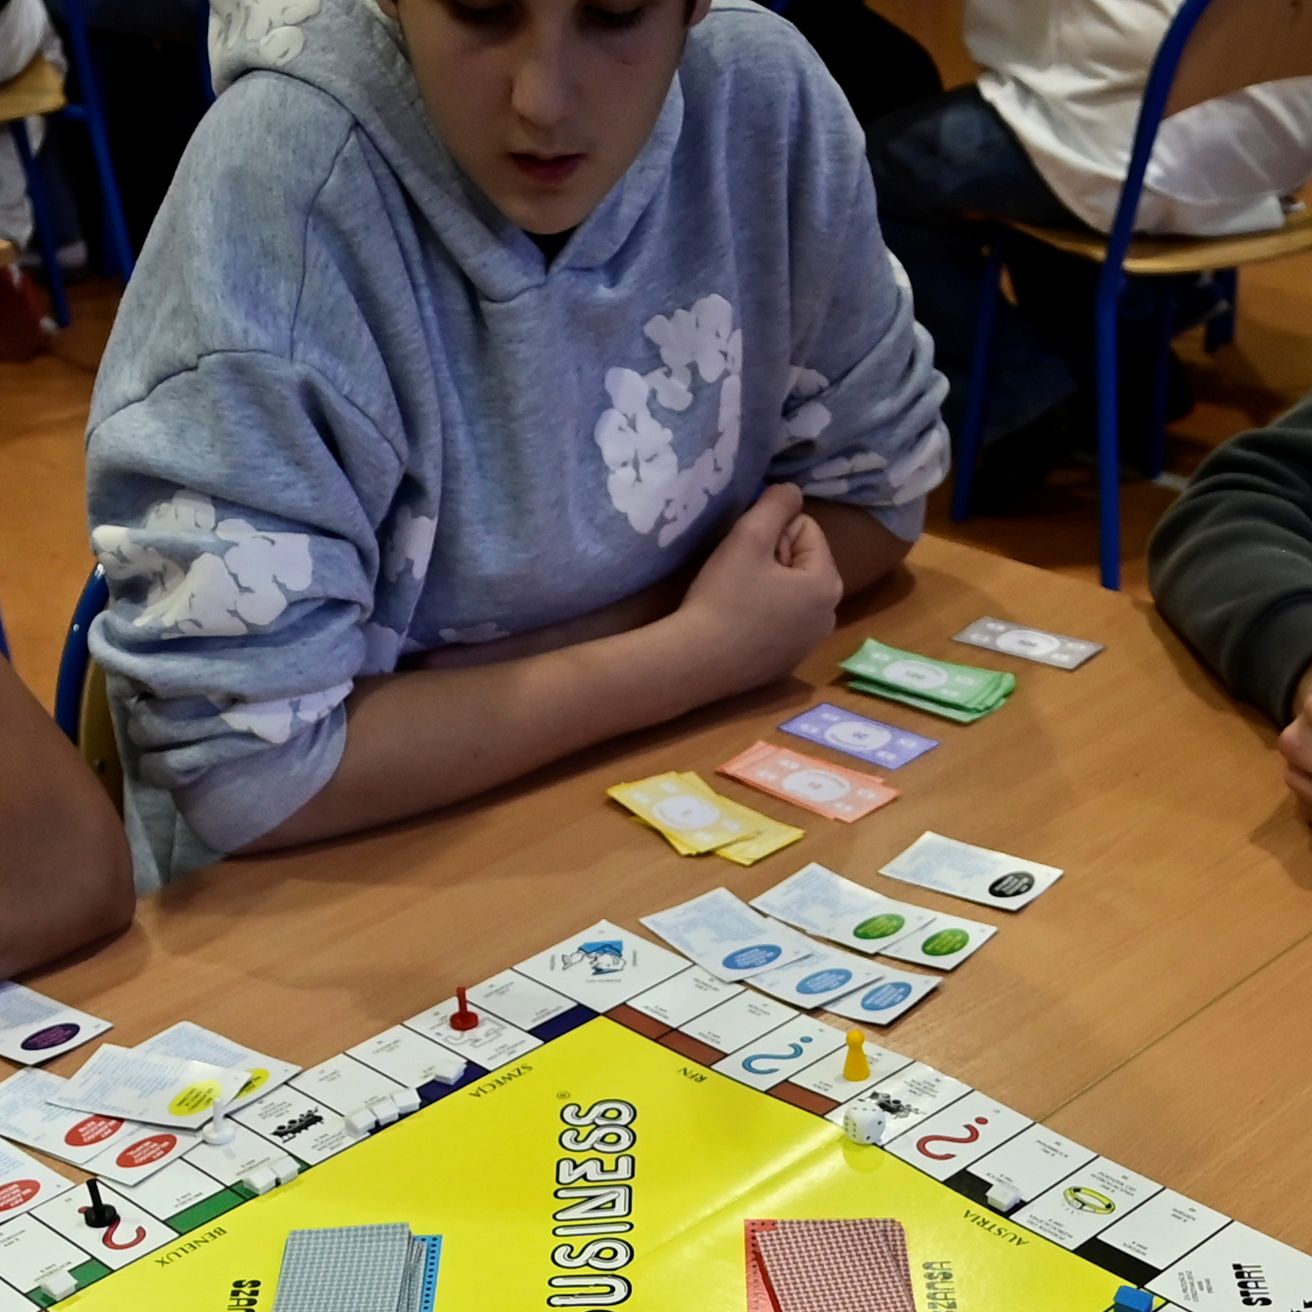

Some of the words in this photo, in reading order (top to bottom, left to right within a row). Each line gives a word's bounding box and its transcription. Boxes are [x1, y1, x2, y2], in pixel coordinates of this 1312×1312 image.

[467, 1061, 535, 1101] SZWECJA
[677, 1067, 707, 1083] RFN
[154, 1226, 229, 1268] BENELUX
[963, 1207, 1029, 1247] AUSTRIA
[1232, 1263, 1273, 1307] START
